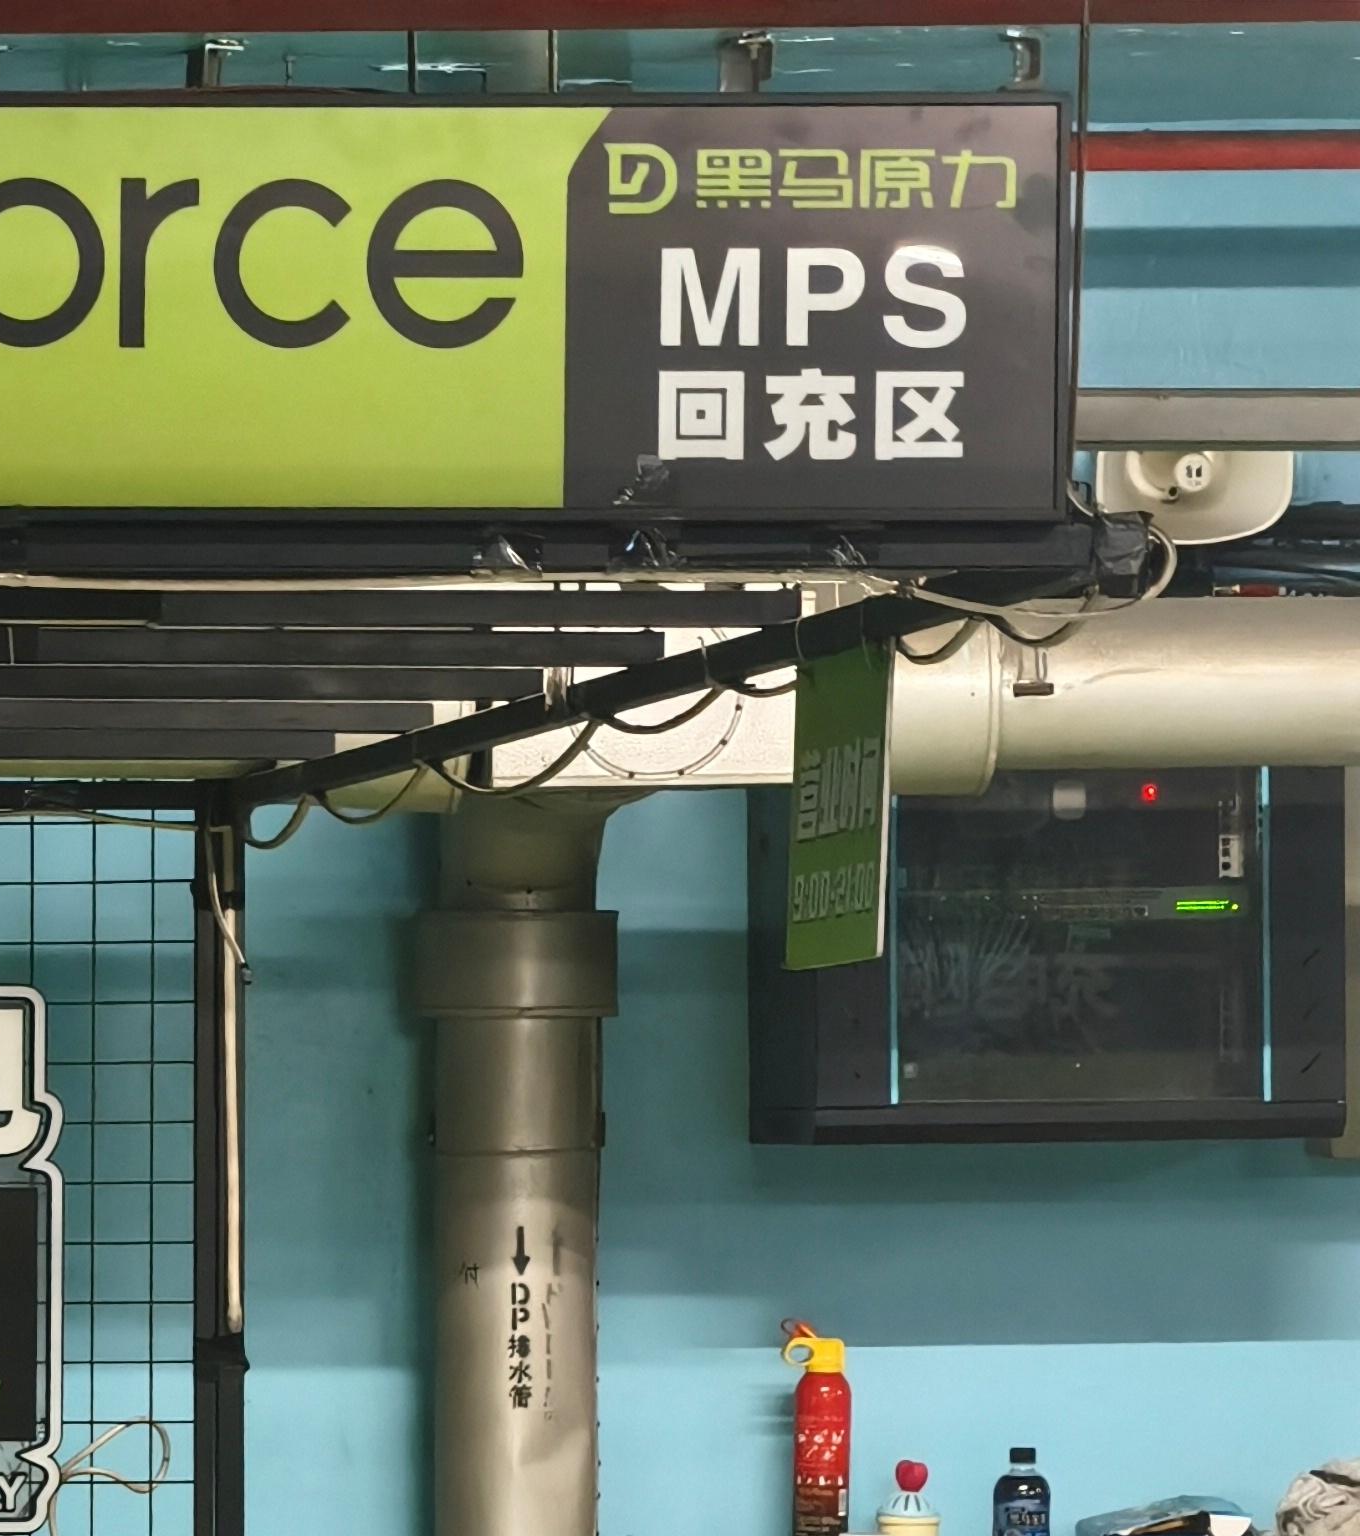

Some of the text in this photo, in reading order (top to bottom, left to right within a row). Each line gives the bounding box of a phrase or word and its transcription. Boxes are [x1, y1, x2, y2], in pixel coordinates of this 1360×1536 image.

[695, 148, 1017, 209] 黑马原力
[659, 244, 968, 349] MPS
[657, 367, 965, 461] 回充区
